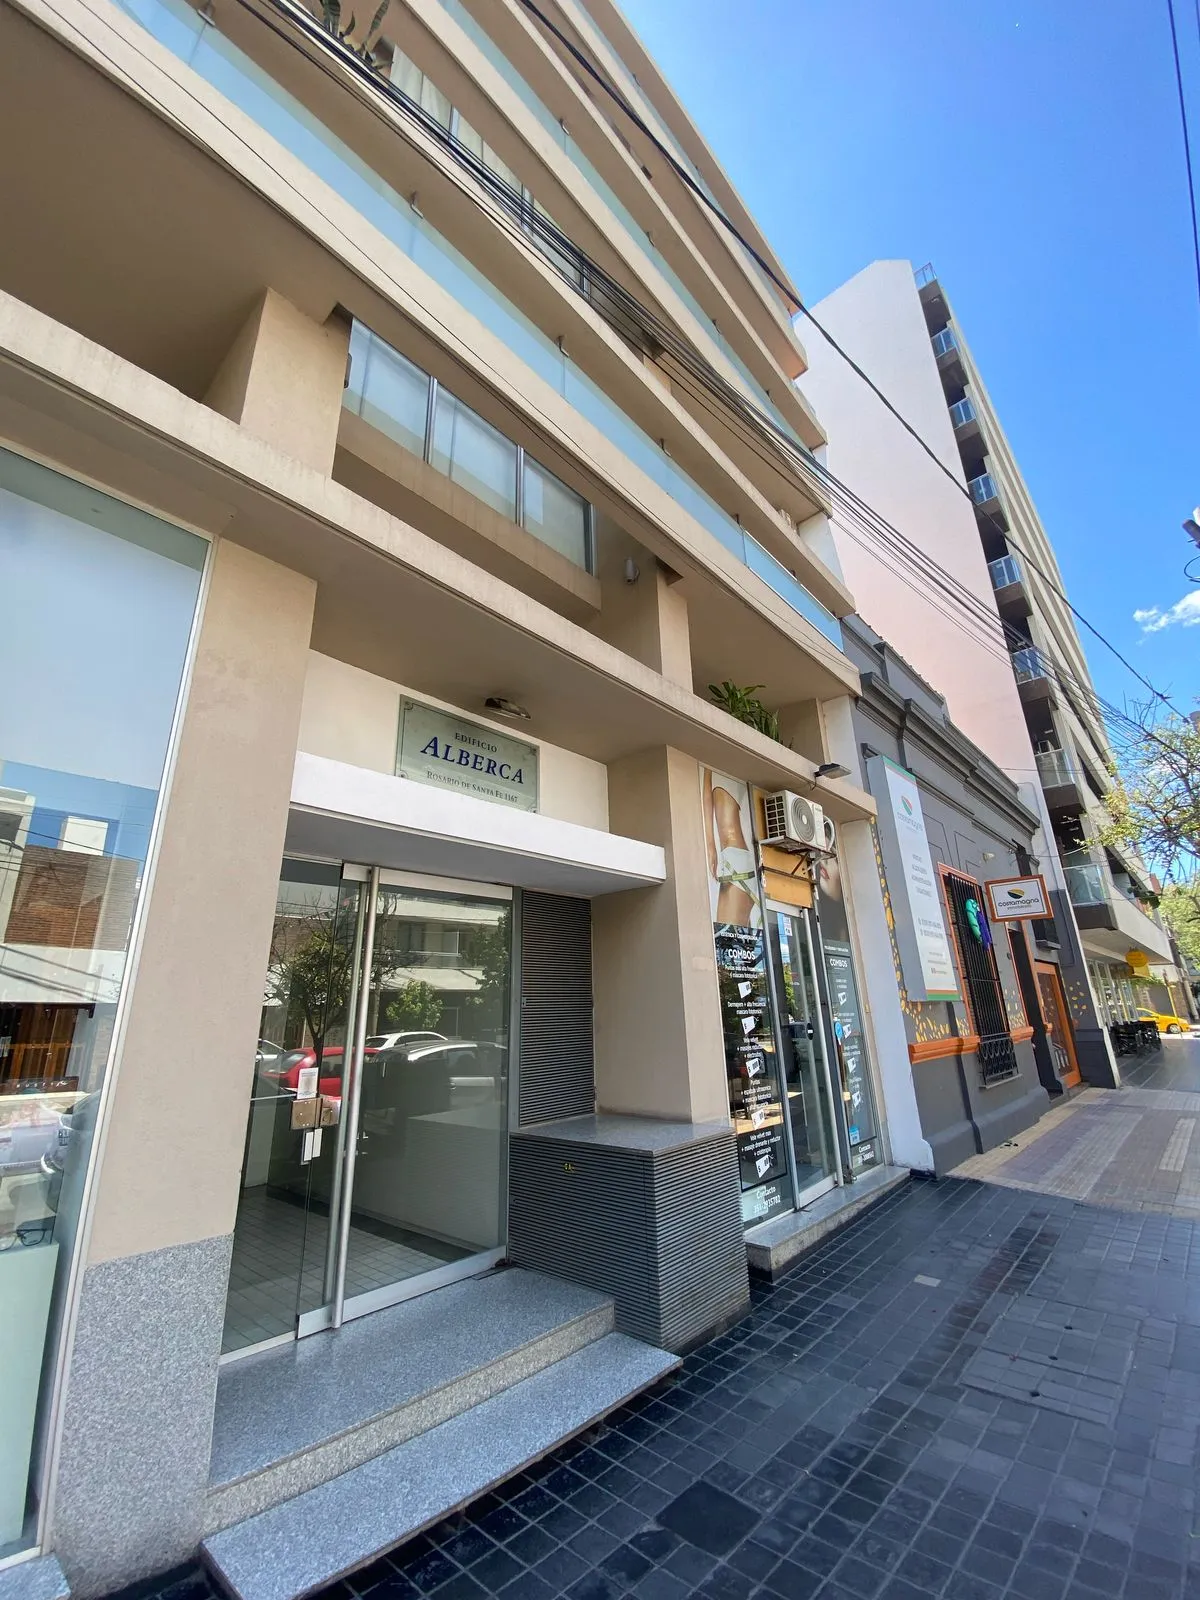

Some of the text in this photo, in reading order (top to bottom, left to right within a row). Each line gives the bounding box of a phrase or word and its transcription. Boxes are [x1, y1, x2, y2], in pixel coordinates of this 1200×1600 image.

[455, 732, 497, 753] EDIFICIO
[420, 736, 524, 784] ALBERCA
[427, 770, 460, 786] ROSARIO
[461, 781, 471, 790] DE
[472, 783, 494, 797] SANTA
[728, 948, 756, 960] COMBOS
